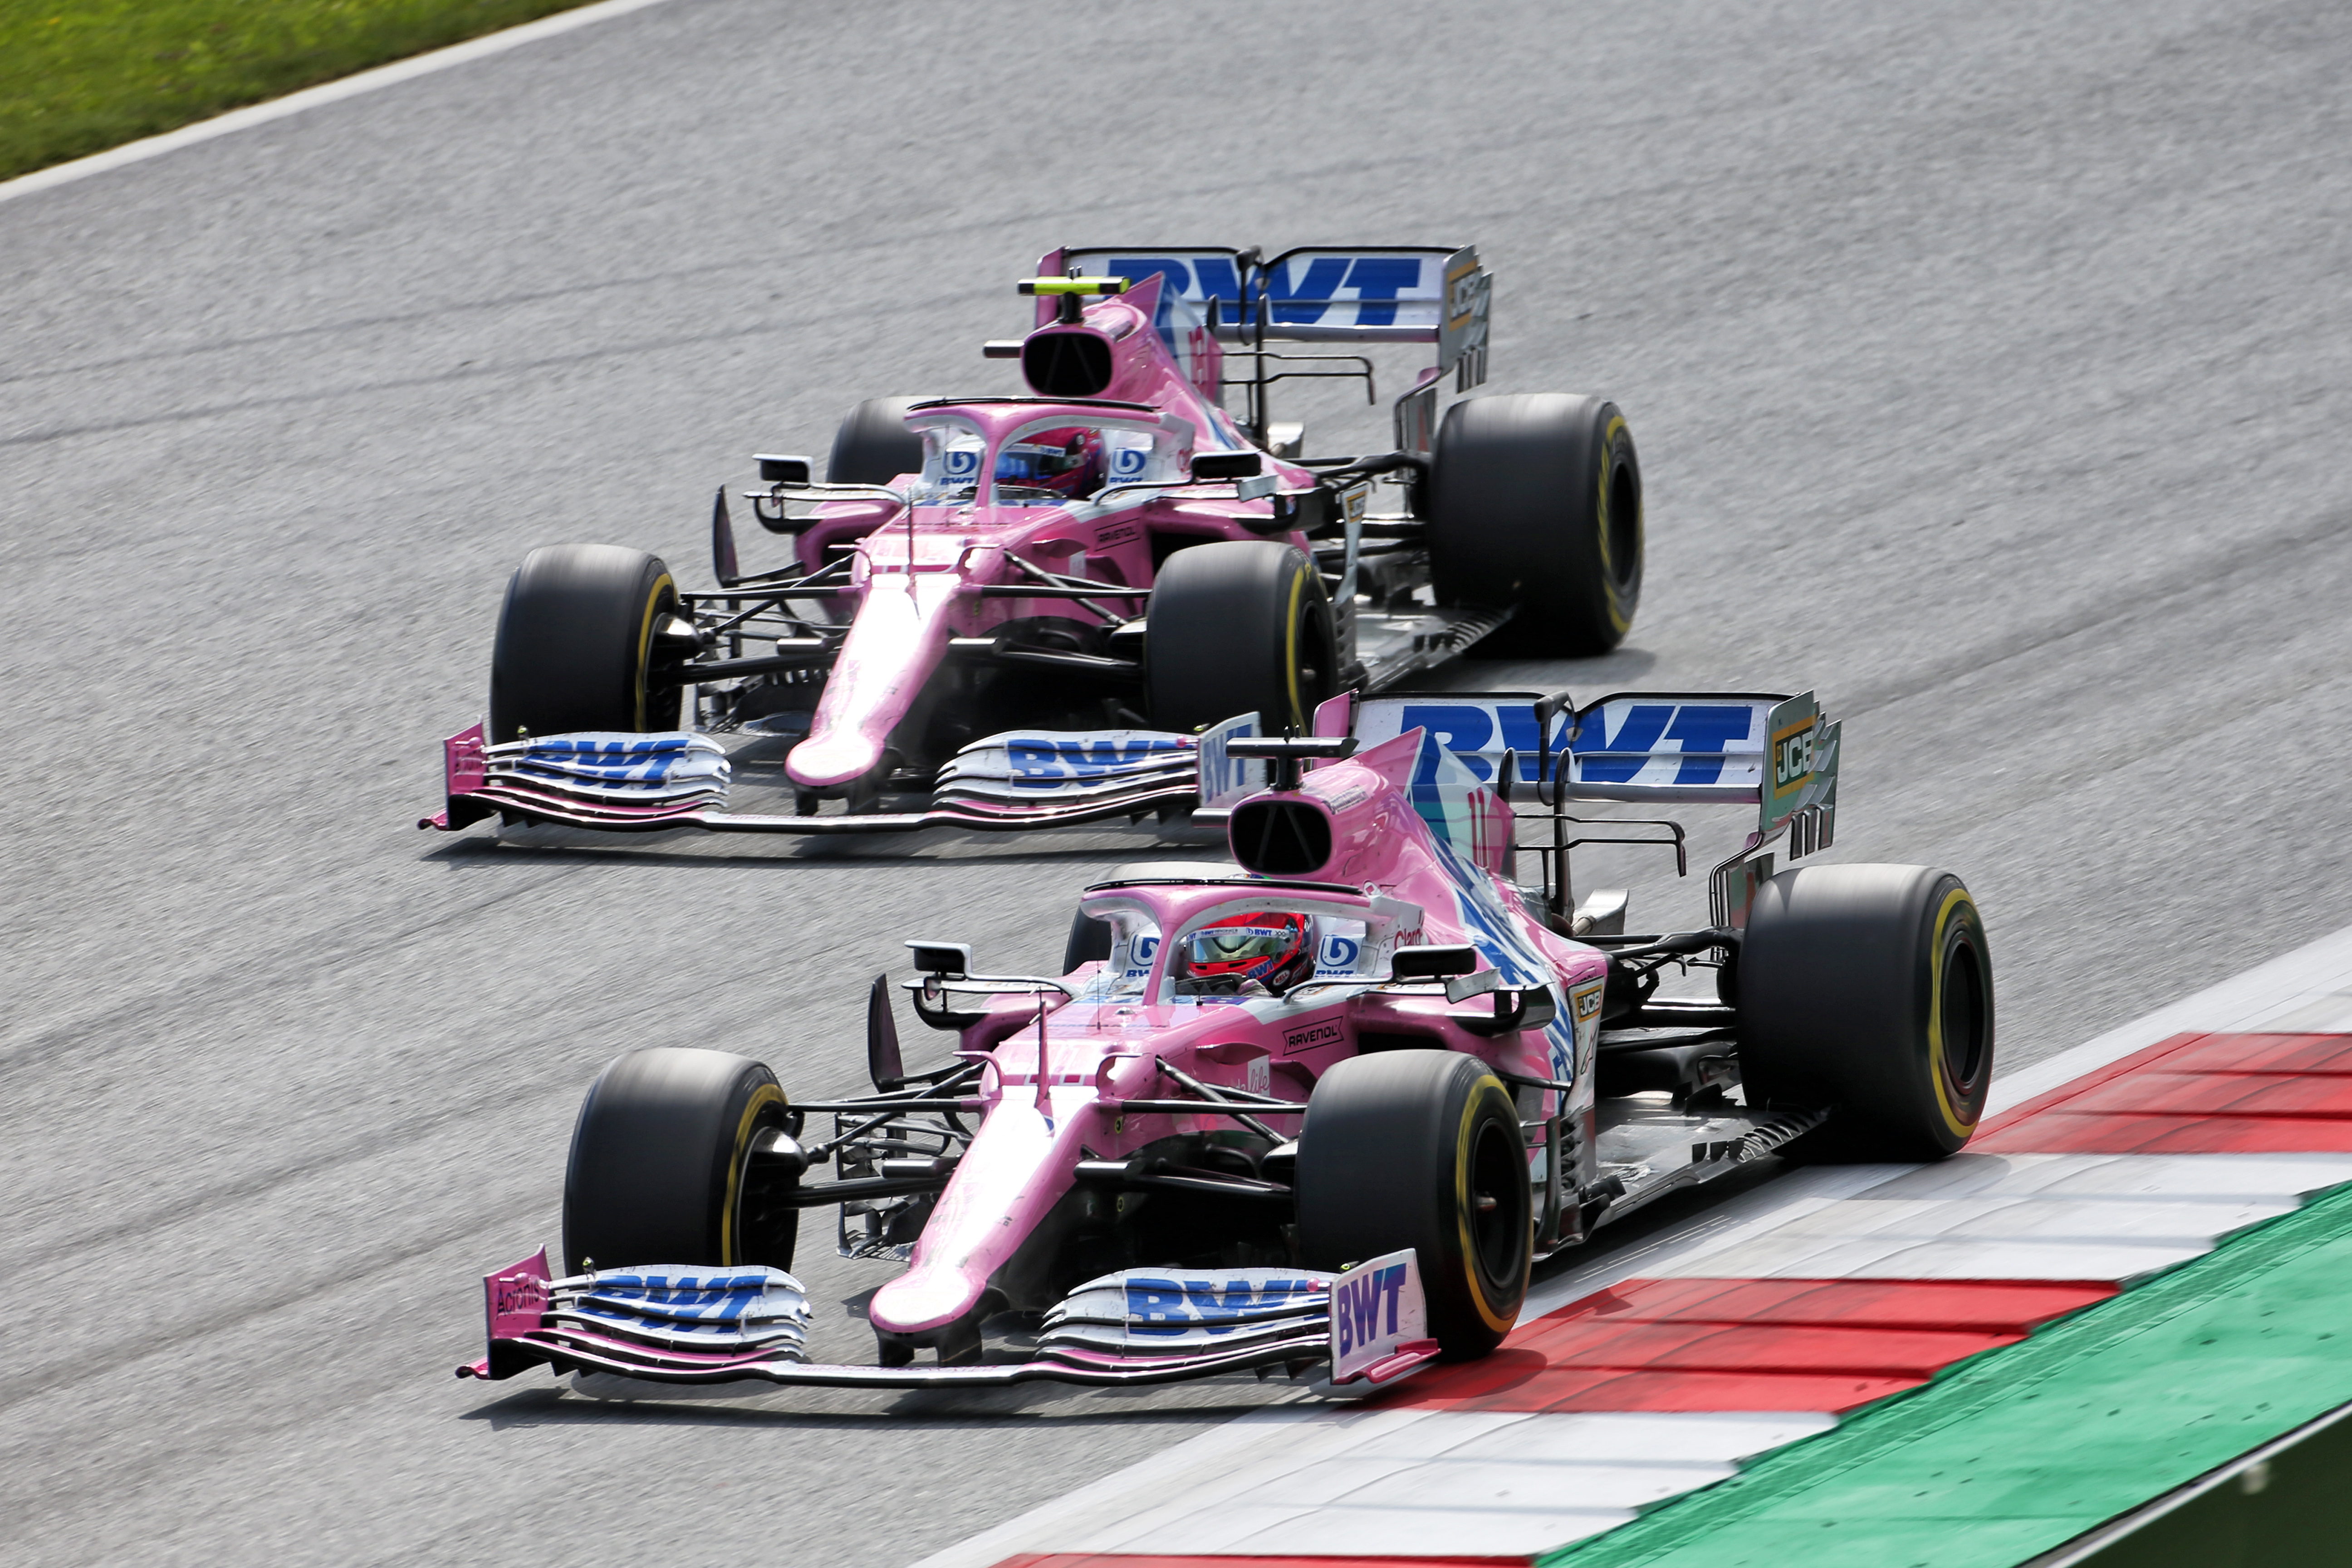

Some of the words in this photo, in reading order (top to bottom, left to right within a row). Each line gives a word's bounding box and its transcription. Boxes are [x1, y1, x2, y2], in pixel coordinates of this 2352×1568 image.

[1401, 706, 1753, 784] BWT
[1247, 959, 1274, 979] BWT
[1275, 973, 1289, 983] BELL
[1580, 991, 1601, 1016] JCB
[1289, 1026, 1338, 1048] RAVENOL
[496, 1281, 541, 1319] Acronis
[1338, 1263, 1407, 1358] BWT
